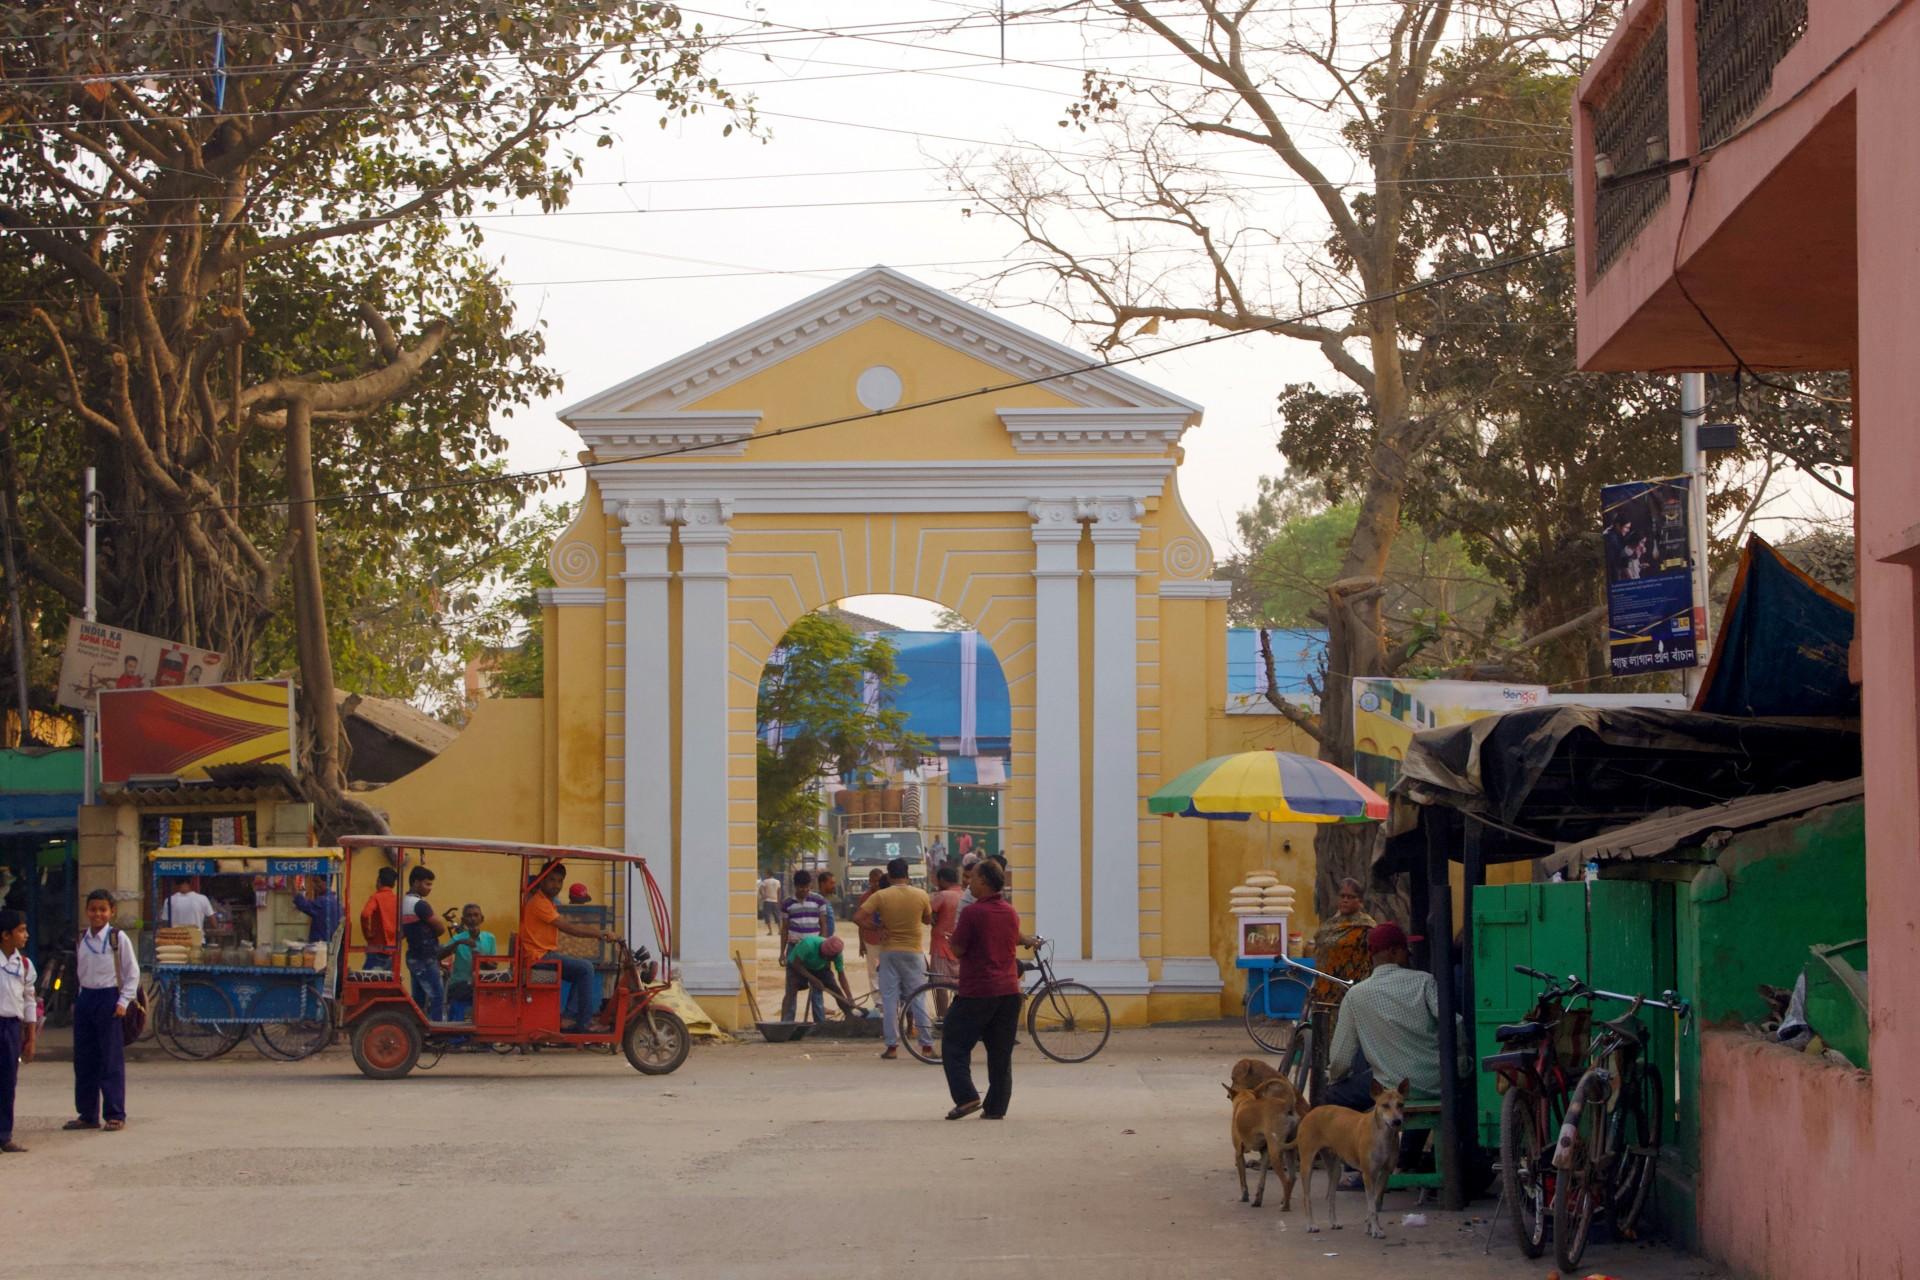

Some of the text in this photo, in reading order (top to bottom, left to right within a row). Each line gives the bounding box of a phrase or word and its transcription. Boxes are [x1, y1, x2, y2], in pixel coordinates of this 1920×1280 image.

[80, 623, 122, 641] INDIA KA
[79, 633, 100, 645] APNA
[102, 638, 121, 649] COLA
[1612, 657, 1628, 669] গাছ
[1629, 654, 1653, 667] লাগান
